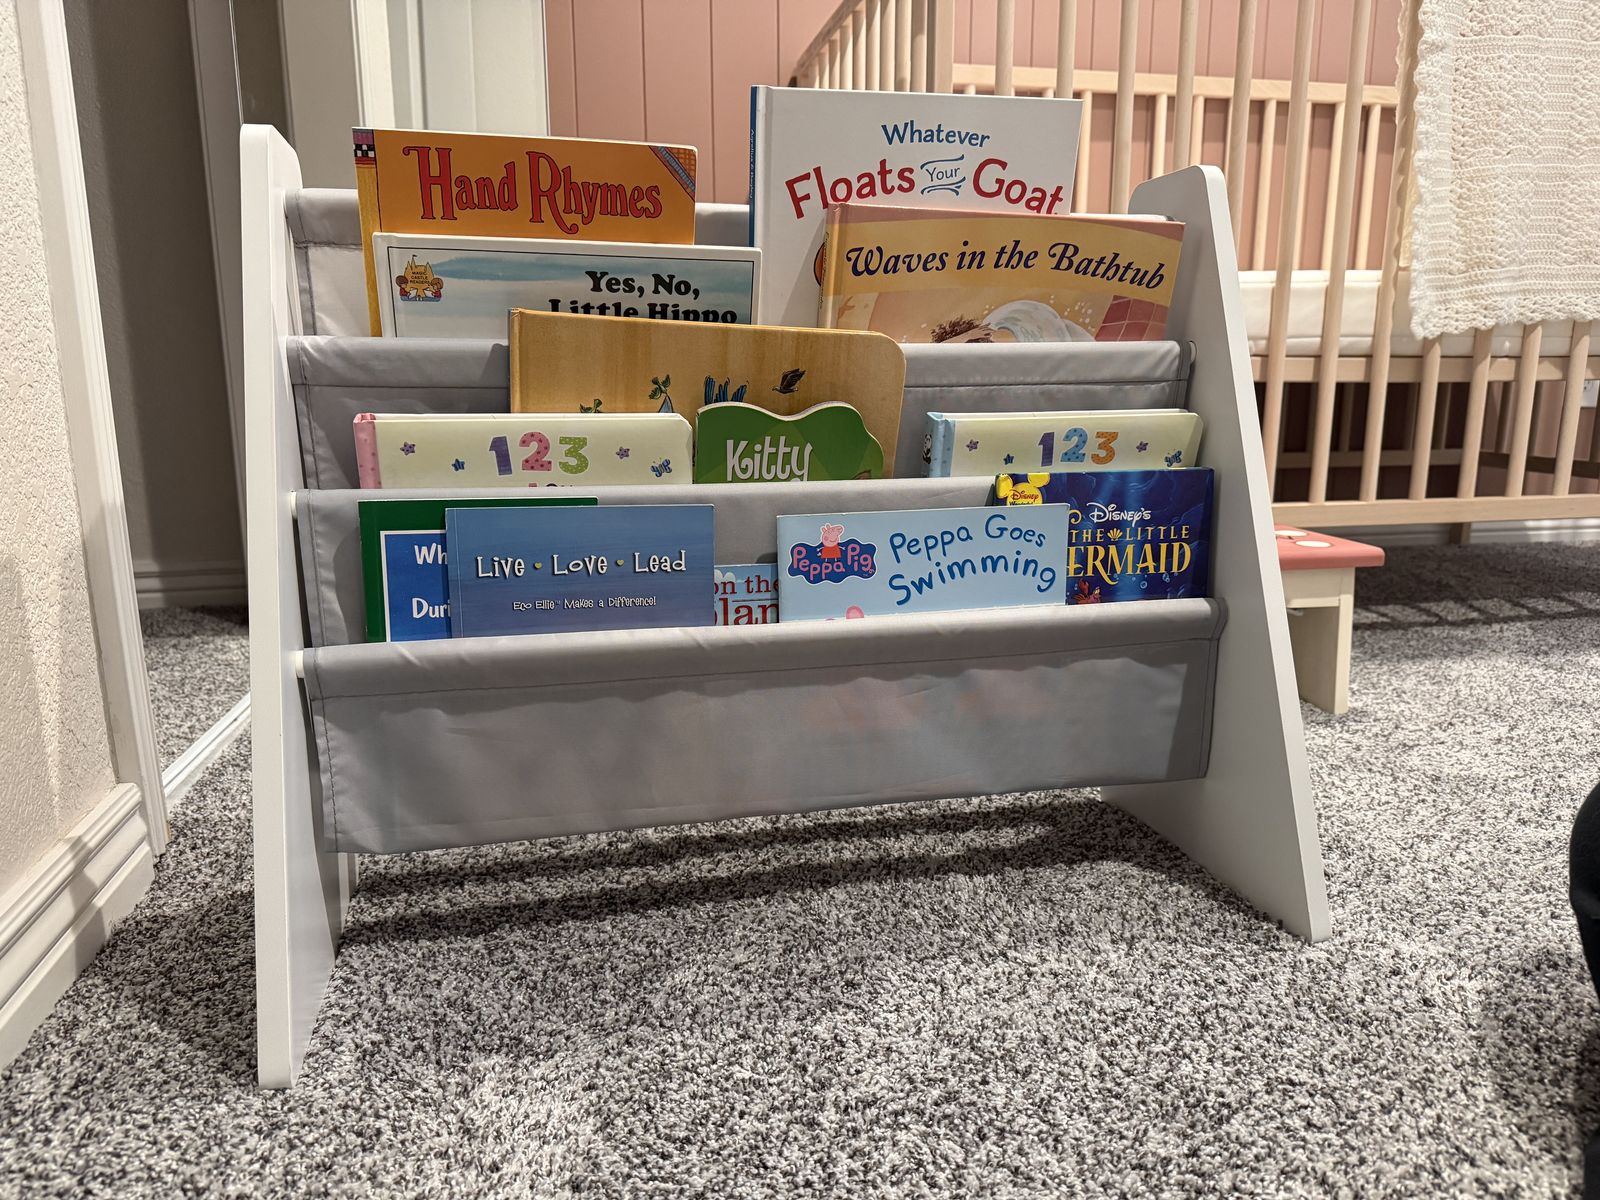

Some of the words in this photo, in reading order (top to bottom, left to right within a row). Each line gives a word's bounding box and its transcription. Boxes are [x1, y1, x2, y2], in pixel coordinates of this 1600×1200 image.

[880, 119, 991, 148] Whatever
[402, 145, 518, 222] Hand
[525, 150, 663, 234] Rhymes
[784, 158, 916, 219] Floats
[925, 166, 961, 183] Your
[972, 157, 1064, 215] Goat
[845, 245, 949, 277] Waves
[957, 240, 985, 271] in
[994, 239, 1039, 270] the
[1048, 241, 1166, 290] Bathtub
[585, 270, 645, 298] Yes,
[651, 273, 700, 300] No,
[726, 435, 813, 481] Kitty
[1009, 489, 1039, 503] Disney
[888, 524, 973, 564] Peppa
[985, 513, 1046, 548] Goes
[1069, 528, 1105, 543] THE
[1125, 525, 1190, 541] LITTLE
[476, 555, 526, 578] Live
[552, 553, 608, 576] Love
[634, 550, 687, 573] Lead
[793, 546, 846, 581] Peppa
[847, 543, 872, 573] Pig
[888, 549, 1057, 606] Swimming
[1067, 541, 1192, 585] ERMAID
[513, 601, 532, 611] Eco
[564, 598, 593, 609] Makes
[598, 600, 604, 608] a
[608, 596, 656, 607] Difference!
[714, 597, 779, 626] lan
